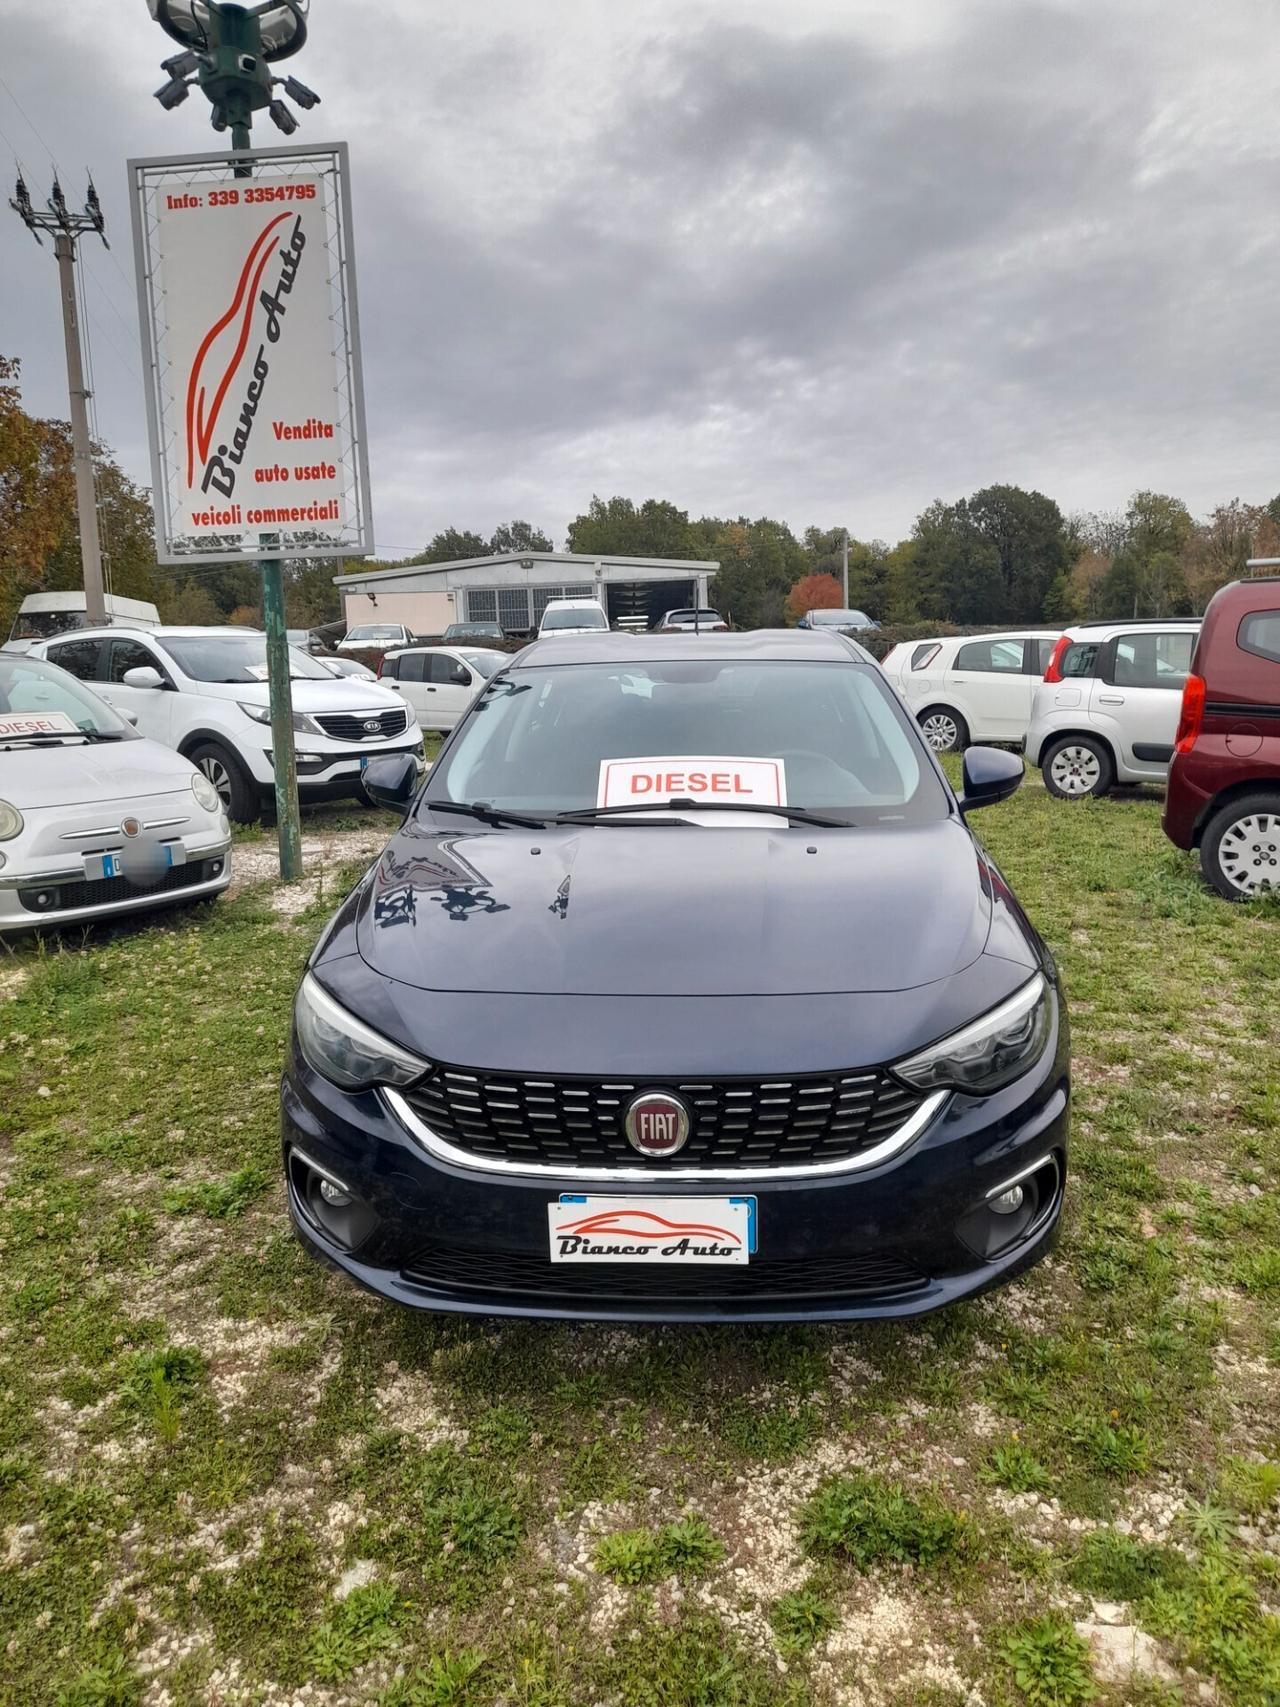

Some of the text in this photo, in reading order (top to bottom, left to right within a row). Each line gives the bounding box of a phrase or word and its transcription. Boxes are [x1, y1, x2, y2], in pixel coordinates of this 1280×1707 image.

[167, 184, 316, 209] Info: 339 3354795
[201, 214, 307, 499] Bianco Auto
[272, 419, 333, 440] Vendita
[255, 462, 336, 482] auto usate
[192, 500, 339, 526] veicoli commerciali
[0, 720, 62, 734] DIESEL
[631, 773, 753, 793] DIESEL
[640, 1113, 676, 1140] FIAT
[556, 1235, 741, 1256] Bianco Auto
